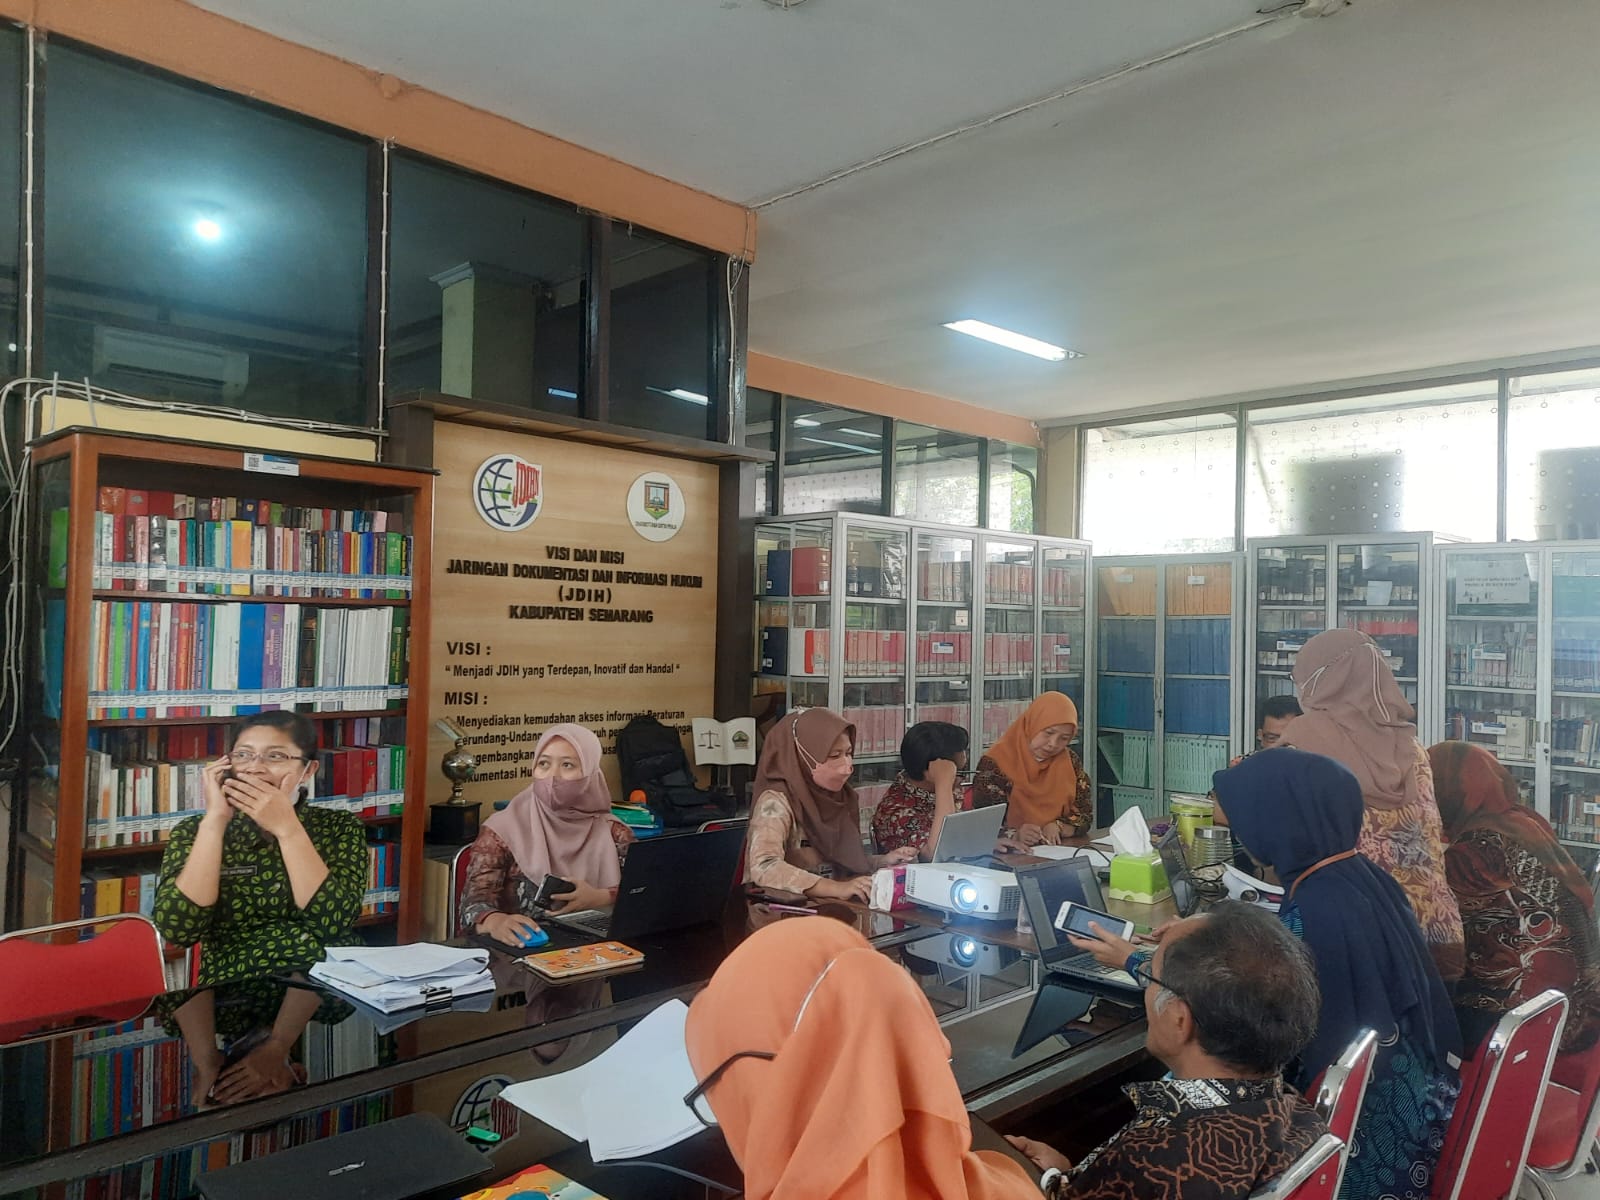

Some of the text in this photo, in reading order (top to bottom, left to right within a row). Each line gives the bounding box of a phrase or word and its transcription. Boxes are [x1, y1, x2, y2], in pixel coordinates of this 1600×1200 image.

[546, 545, 625, 565] VISI DAN MISI
[446, 559, 703, 588] JARINGAN DOKUMENTASI DAN INFORMASI HUKUM
[558, 585, 612, 604] (JDIH)
[509, 605, 654, 623] KABUPATEN SEMARANG
[447, 641, 481, 656] VISI
[453, 664, 493, 680] Menjadi
[496, 664, 520, 676] JDIH
[522, 667, 545, 679] yang
[547, 663, 592, 678] Terdepan,
[594, 663, 627, 675] Inovatif
[628, 663, 644, 674] dan
[646, 663, 674, 674] Handal
[444, 691, 479, 706] MISI
[456, 713, 521, 730] Menyediakan
[524, 711, 576, 725] kemudahan
[578, 711, 605, 723] akses
[461, 731, 543, 746] erundang-Undan
[472, 749, 535, 766] gembangkan
[464, 766, 533, 784] umentasi Hu
